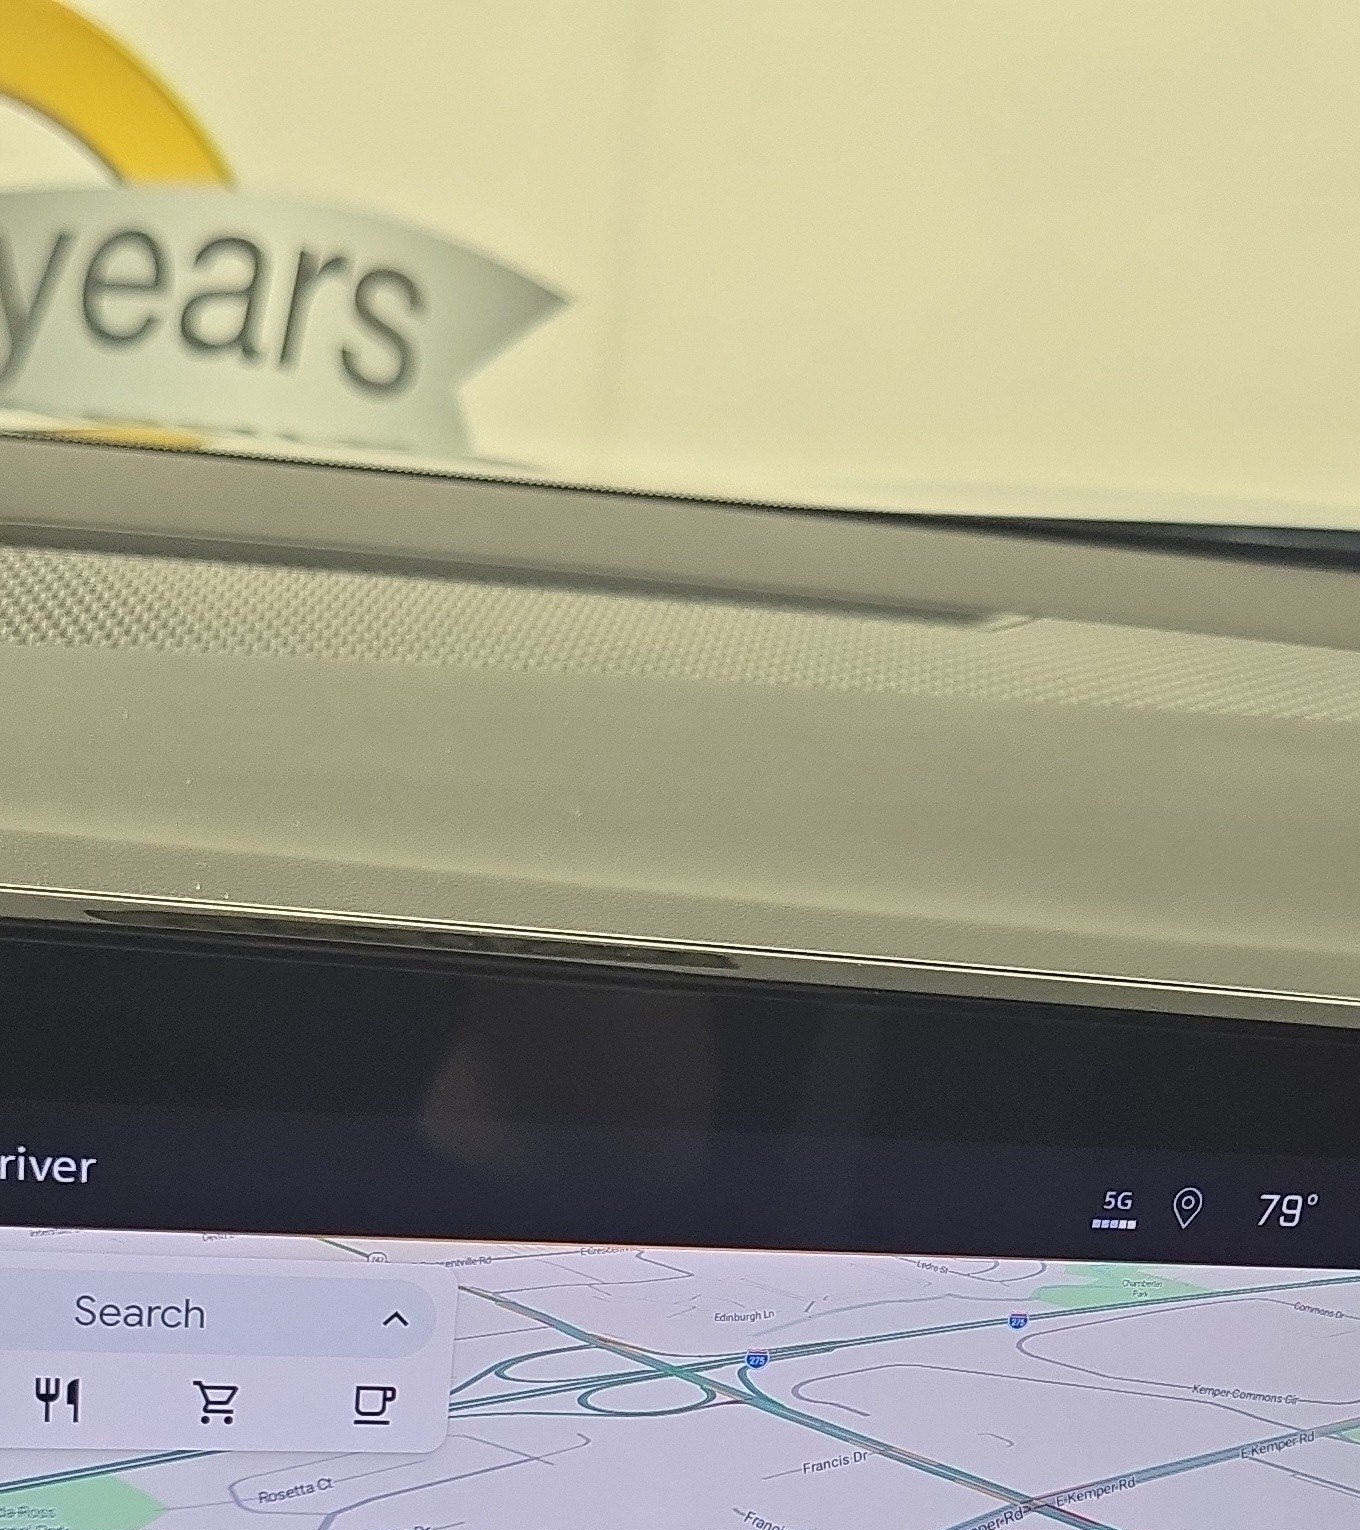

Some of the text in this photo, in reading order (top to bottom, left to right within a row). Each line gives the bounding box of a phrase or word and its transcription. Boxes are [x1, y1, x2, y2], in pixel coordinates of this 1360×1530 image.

[1103, 1191, 1133, 1210] 5G
[1257, 1194, 1319, 1227] 79°
[75, 1295, 205, 1328] Search
[713, 1308, 775, 1324] Edinburgh Ln
[1192, 1383, 1230, 1401] Kemper
[1231, 1388, 1283, 1405] Commons
[1251, 1437, 1297, 1458] Kemper
[1298, 1430, 1316, 1446] Rd
[802, 1450, 869, 1475] Francis Dr
[258, 1477, 334, 1504] Rosetta Ct
[1067, 1484, 1115, 1504] Kemper
[1118, 1476, 1136, 1491] Rd
[1003, 1507, 1025, 1525] Rd
